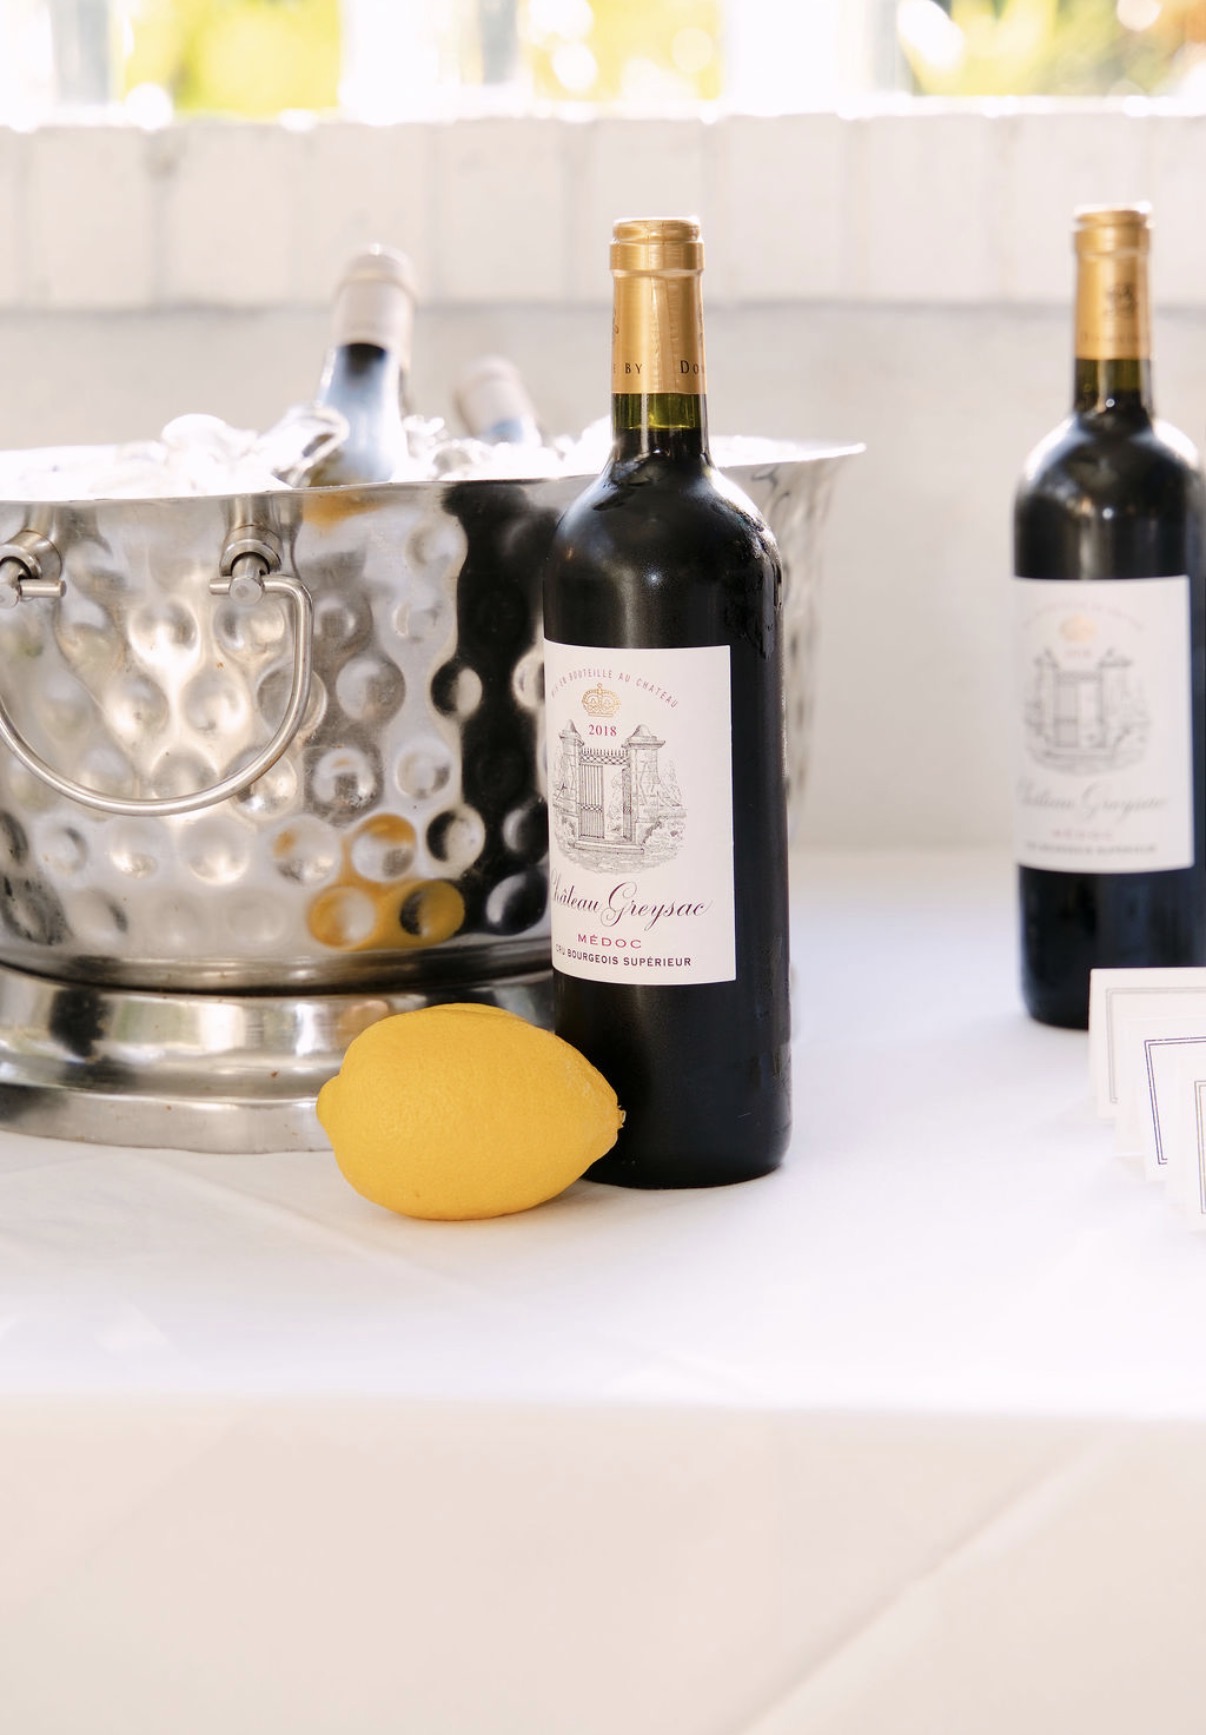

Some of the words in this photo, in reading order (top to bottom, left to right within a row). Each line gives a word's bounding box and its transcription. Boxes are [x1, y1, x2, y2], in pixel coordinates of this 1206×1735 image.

[624, 362, 642, 374] BY
[568, 668, 613, 682] BOUTEILLE
[618, 672, 631, 683] AU
[636, 678, 679, 709] CHATEAU
[588, 723, 617, 737] 2018
[600, 881, 713, 932] Greysac
[577, 933, 642, 949] MÉDOC
[567, 948, 619, 966] BOURGEOIS
[623, 956, 691, 968] SUPÉRIEUR
